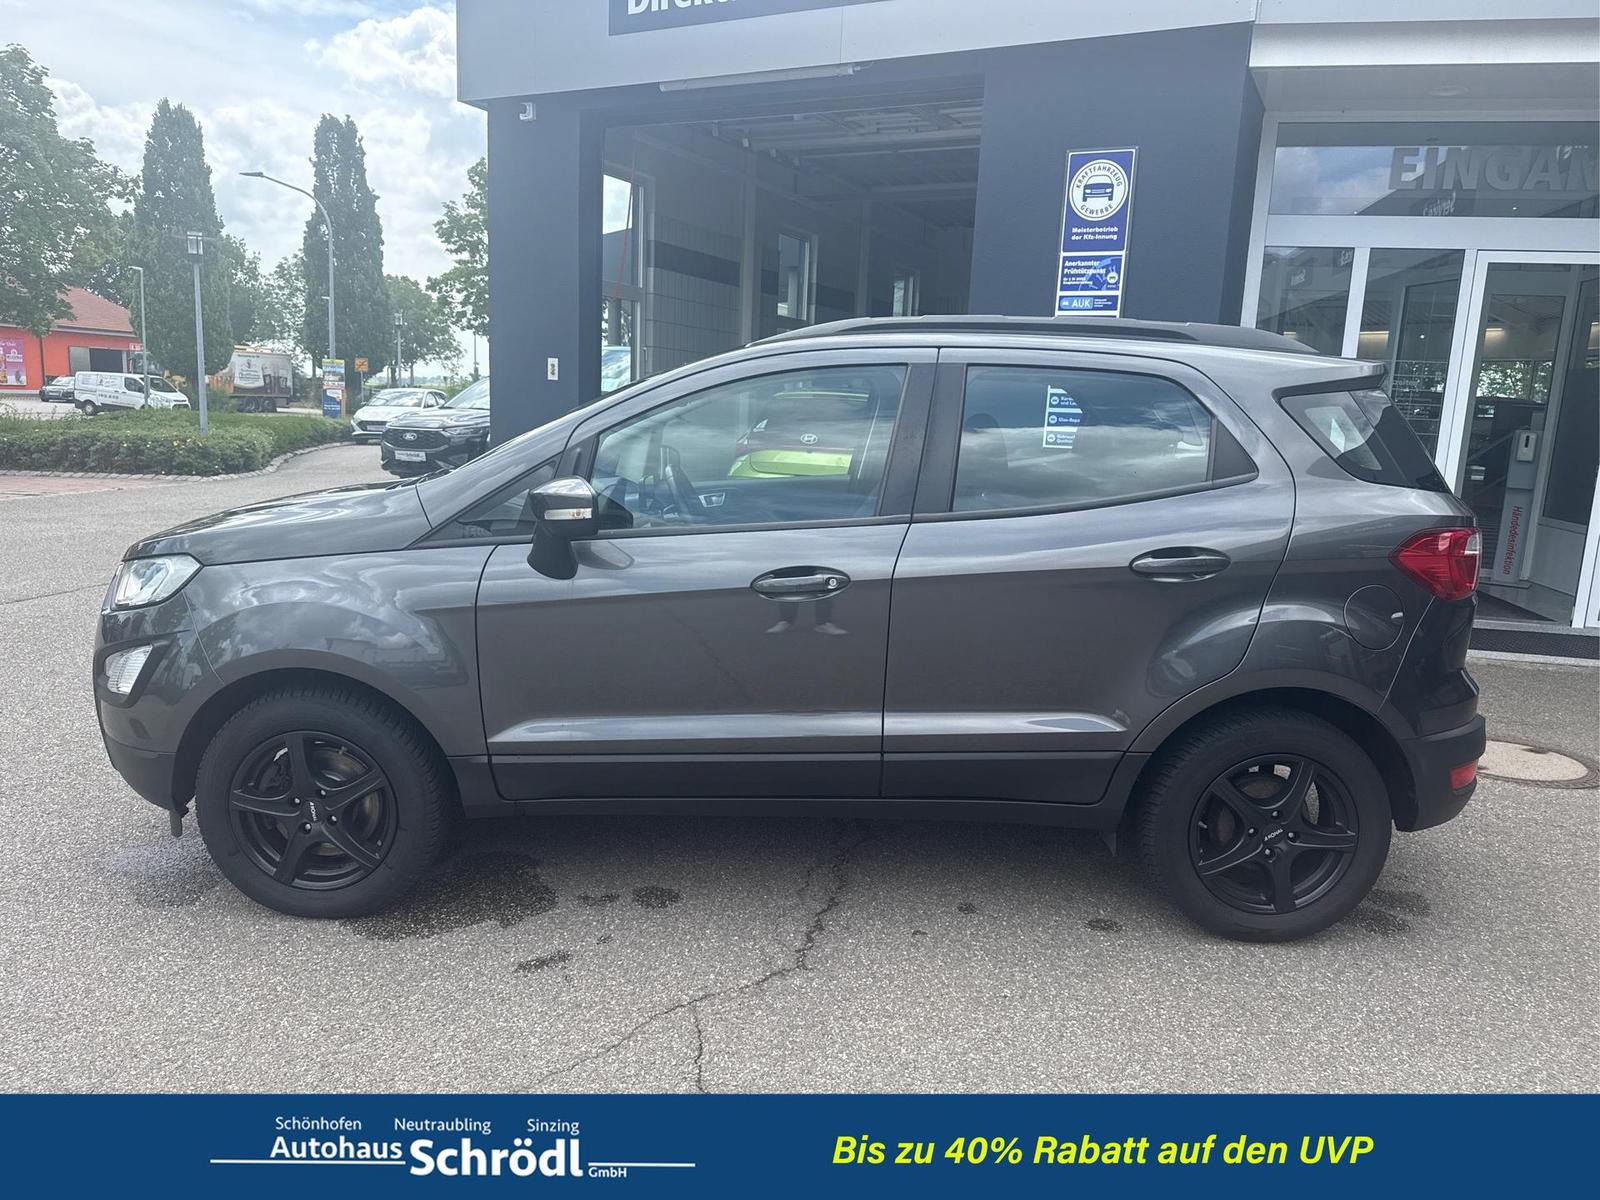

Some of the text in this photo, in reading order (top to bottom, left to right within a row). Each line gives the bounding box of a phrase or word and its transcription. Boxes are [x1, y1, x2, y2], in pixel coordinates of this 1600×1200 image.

[1076, 165, 1123, 189] KRAFTFAHRZEUG
[1080, 203, 1113, 215] GEWERBE
[1071, 298, 1091, 308] AUK
